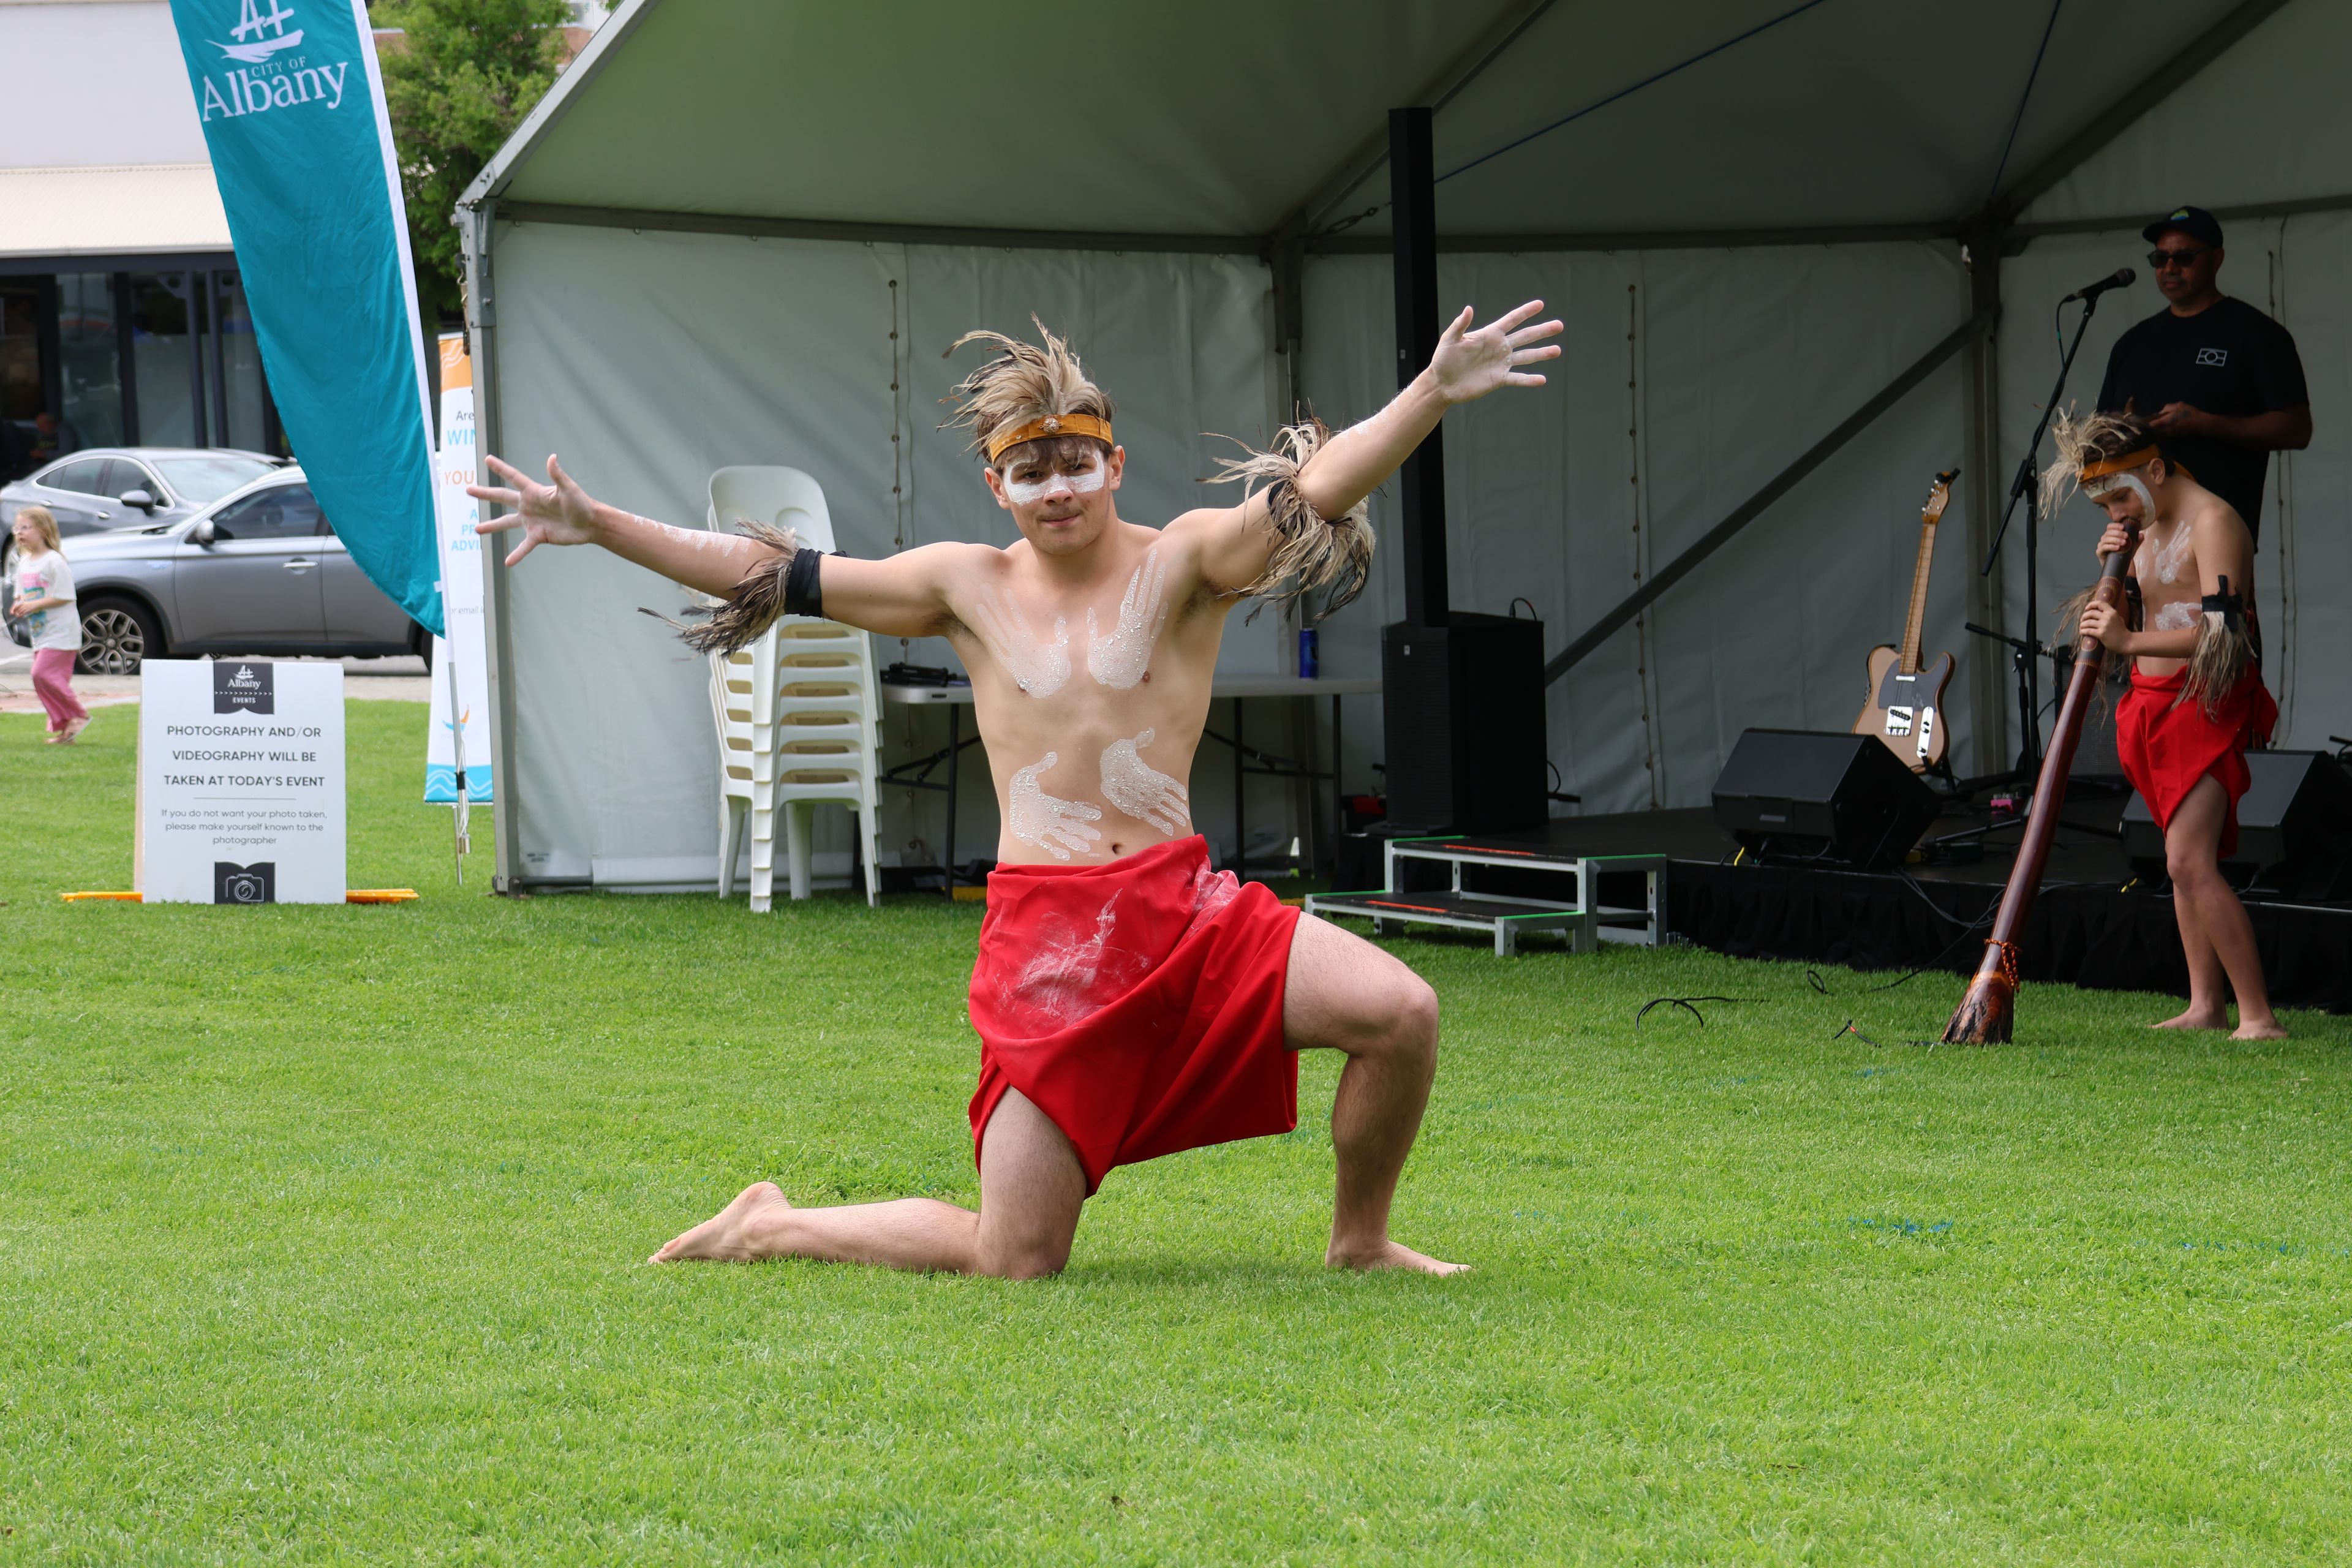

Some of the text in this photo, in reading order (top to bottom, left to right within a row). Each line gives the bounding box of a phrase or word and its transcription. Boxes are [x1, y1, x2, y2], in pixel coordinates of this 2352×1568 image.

[251, 56, 306, 78] CITY OF
[203, 62, 349, 122] Albany
[228, 678, 262, 690] Albany
[167, 726, 322, 738] PHOTOGRAPHY AND/OR
[173, 750, 317, 761] VIDEOGRAPHY WILL BE
[164, 775, 325, 786] TAKEN AT TODAY'S EVENT
[170, 810, 186, 819] you
[270, 810, 297, 819] photo
[166, 823, 197, 831] please
[227, 823, 263, 832] yourself
[213, 836, 277, 845] photographer
